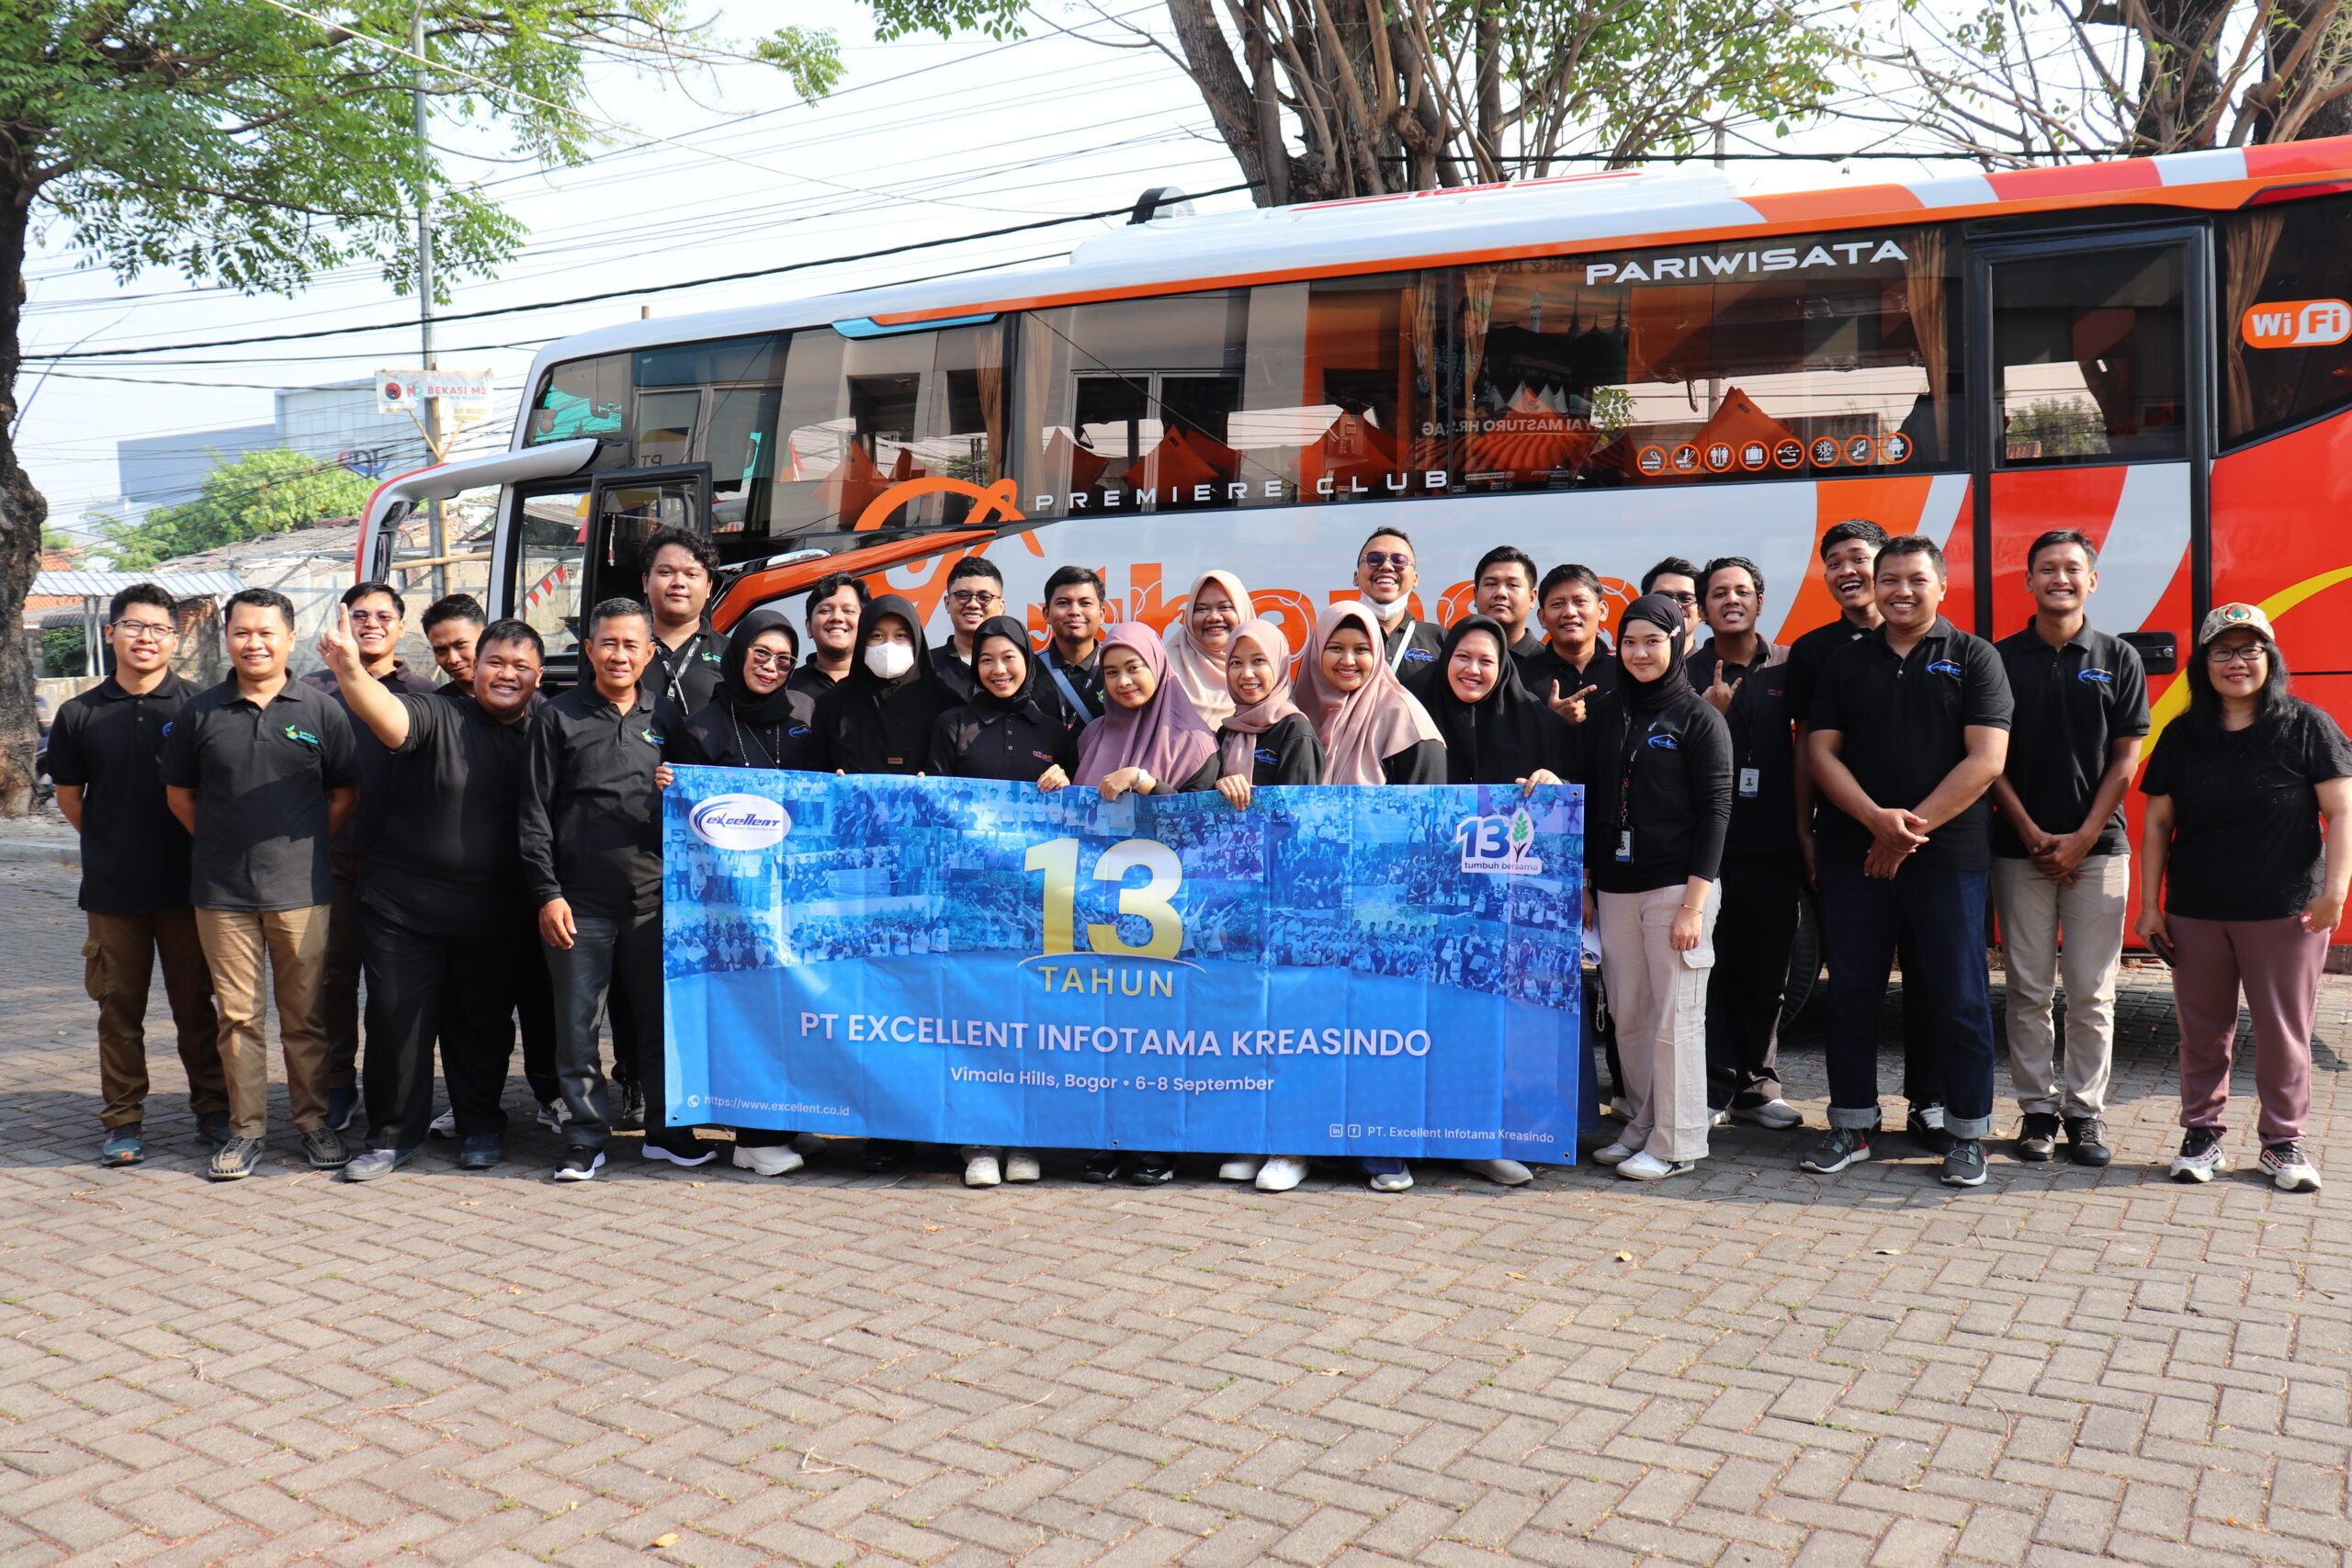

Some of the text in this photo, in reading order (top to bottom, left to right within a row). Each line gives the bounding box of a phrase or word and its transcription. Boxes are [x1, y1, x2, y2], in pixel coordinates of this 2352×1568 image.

[1587, 240, 1909, 286] PARIWISATA
[427, 386, 487, 395] BEKASI M2
[1035, 469, 1448, 512] PREMIERE CLUB
[1460, 818, 1510, 859] 13
[1464, 862, 1538, 871] tumbuh bersama
[1023, 838, 1184, 960] 13
[1037, 965, 1173, 998] TAHUN
[800, 1011, 1431, 1057] PT EXCELLENT INFOTAMA KREASINDO
[950, 1066, 1275, 1096] Vimala Hills, Bogor 6-8 September
[704, 1095, 850, 1117] https://www.excellent.co.id
[1367, 1126, 1386, 1137] PT.
[1389, 1126, 1442, 1138] Excellent
[1444, 1127, 1496, 1140] Infotama
[1498, 1128, 1555, 1144] Kreasindo
